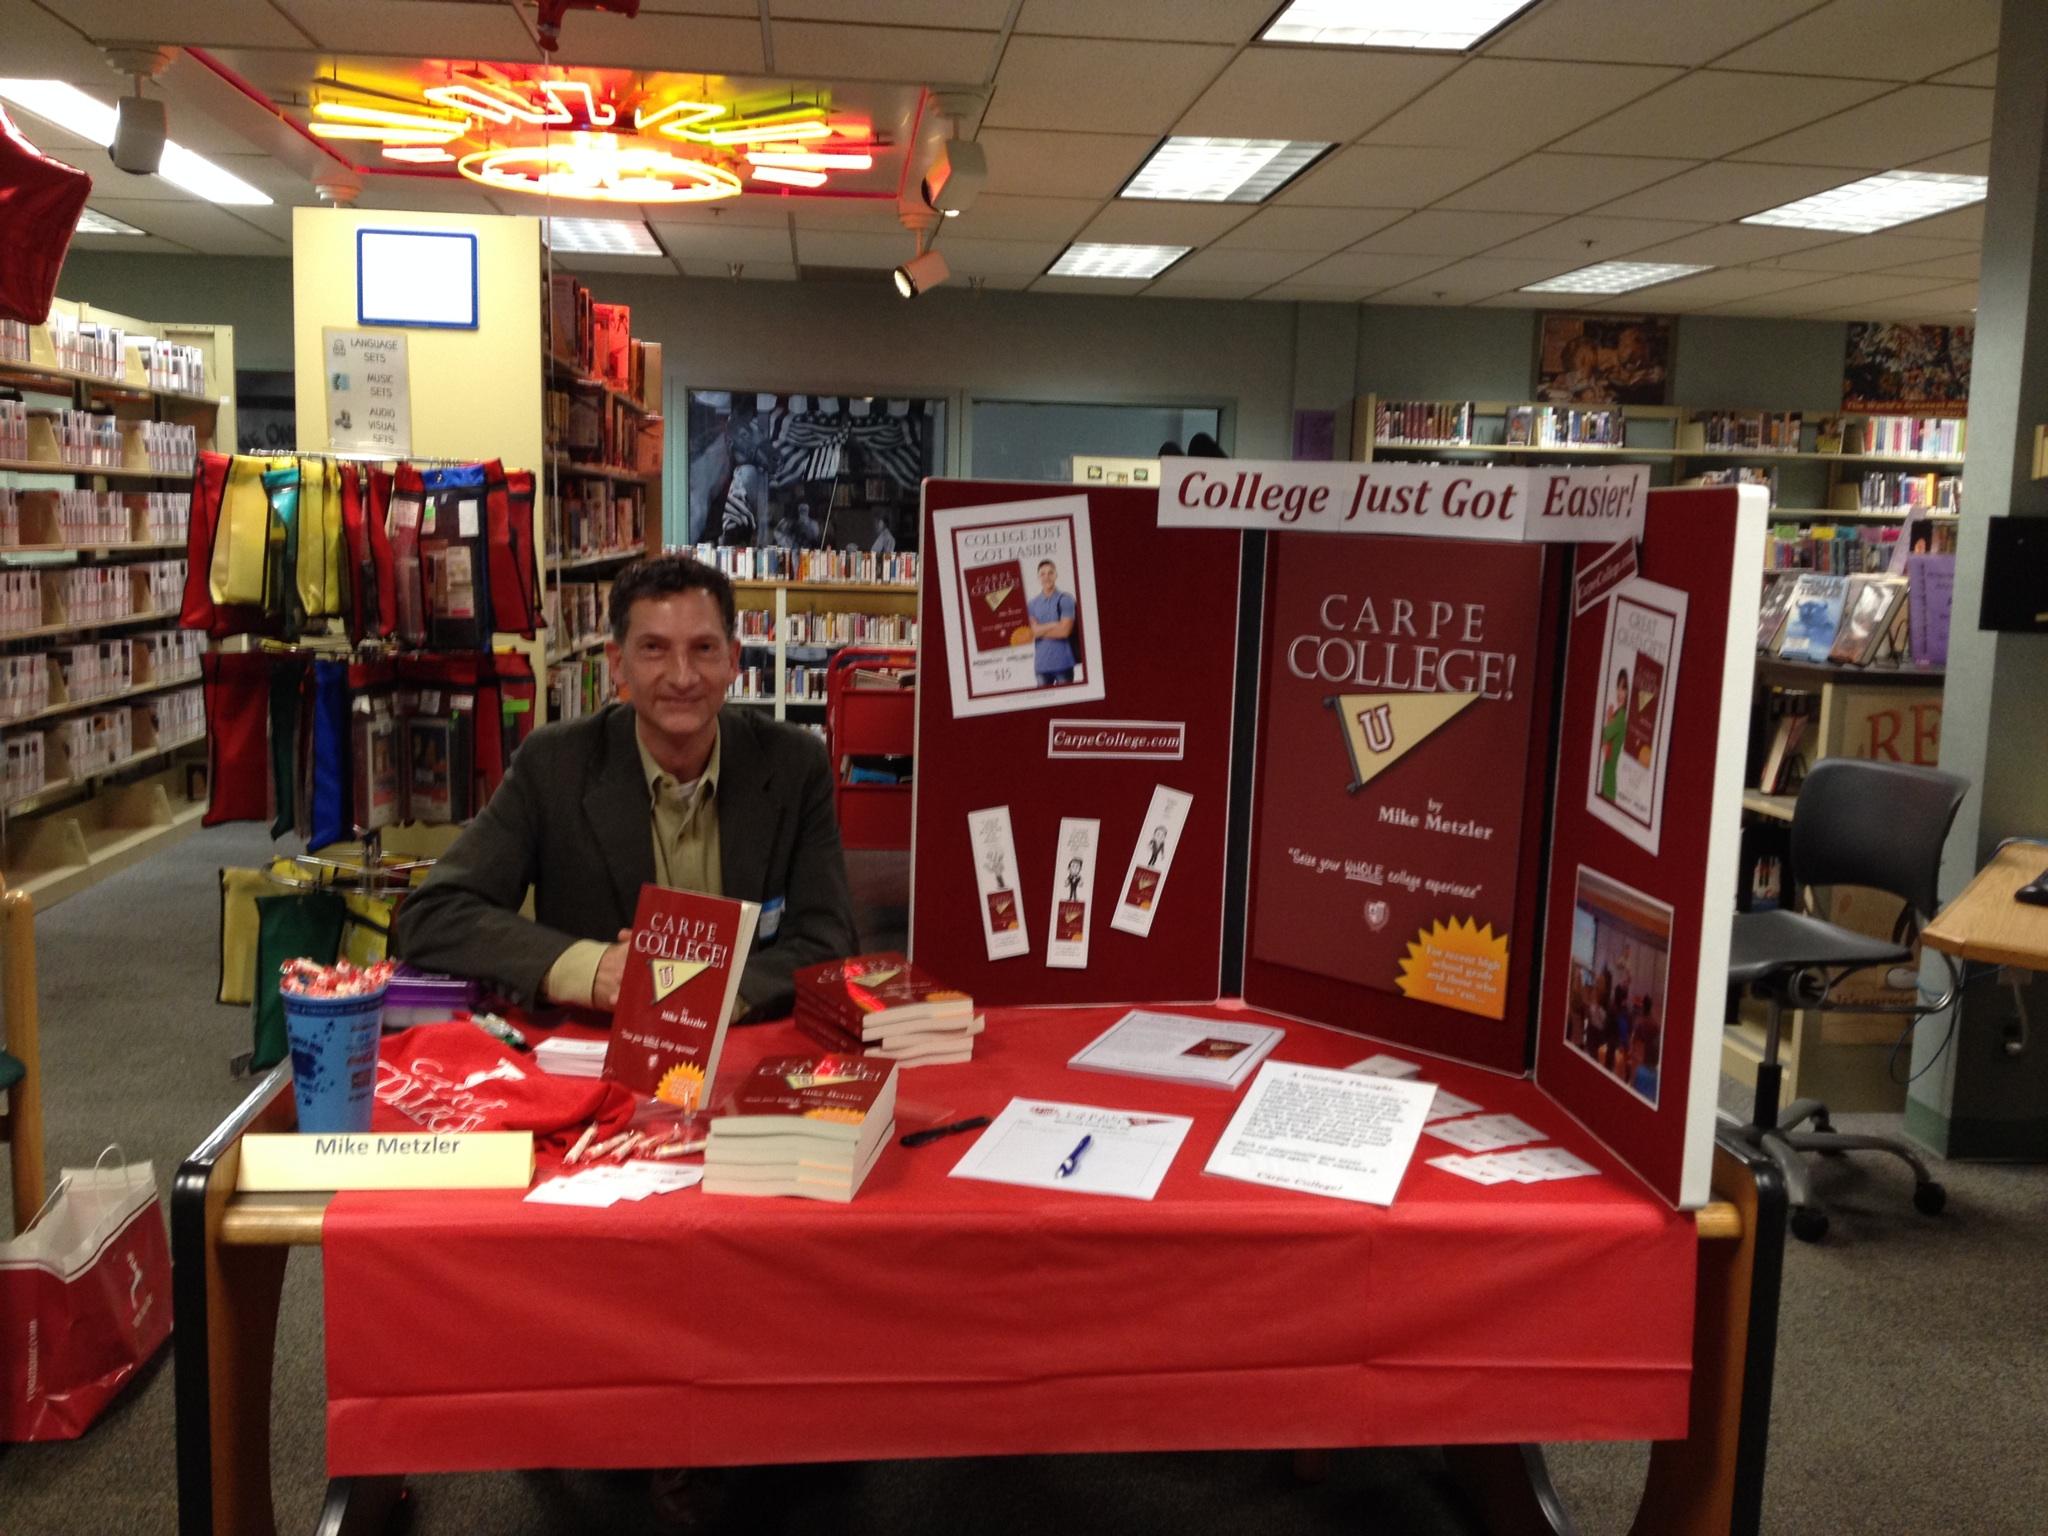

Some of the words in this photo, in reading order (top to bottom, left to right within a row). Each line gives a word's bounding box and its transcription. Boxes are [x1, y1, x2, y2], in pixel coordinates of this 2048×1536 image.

[350, 338, 398, 351] LANGUAGE
[364, 352, 386, 363] SETS
[367, 373, 393, 384] MUSIC
[370, 387, 393, 398] SETS
[369, 408, 395, 418] AUDIO
[368, 420, 397, 432] VISUAL
[373, 434, 394, 445] SETS
[1178, 471, 1329, 523] College
[1345, 474, 1432, 521] Just
[1442, 478, 1517, 521] Got
[1542, 474, 1638, 518] Easier!
[964, 528, 1028, 548] COLLEGE
[1031, 525, 1061, 543] JUST
[973, 549, 1002, 563] GOT
[1009, 542, 1057, 560] EASIER!
[1320, 594, 1486, 642] CARPE
[1287, 635, 1517, 701] COLLEGE!
[1357, 703, 1395, 754] U
[1053, 731, 1180, 748] CarpeCollege.com
[1428, 798, 1443, 814] by
[1377, 805, 1420, 828] Mike
[1424, 814, 1494, 841] Metzler
[650, 912, 718, 943] CARPE
[635, 929, 728, 969] COLLEGE!
[658, 965, 674, 988] U
[661, 1009, 678, 1024] Mike
[315, 1137, 369, 1155] Mike
[377, 1136, 460, 1155] Metzler
